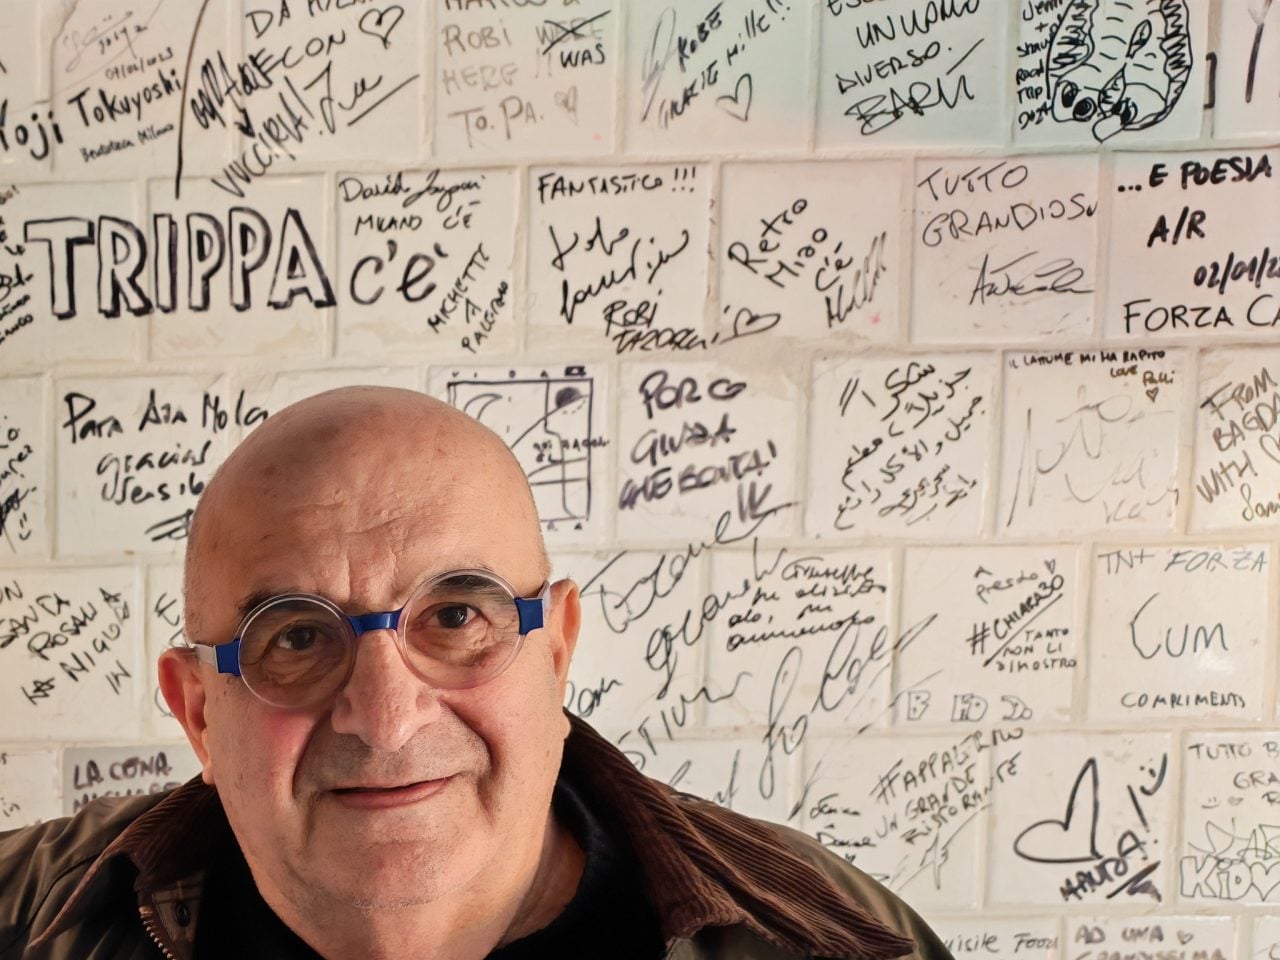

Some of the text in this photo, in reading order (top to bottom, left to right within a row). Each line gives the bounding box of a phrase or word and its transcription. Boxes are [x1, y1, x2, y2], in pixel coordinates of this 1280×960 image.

[560, 44, 606, 69] WAS
[67, 69, 182, 127] Tokuyoshi
[917, 162, 1029, 201] TUTTO
[1181, 154, 1272, 190] POESIA
[728, 199, 807, 274] Retro
[1147, 207, 1206, 248] A/R
[24, 208, 337, 319] TRIPPA
[1123, 297, 1236, 333] FORZA
[1200, 367, 1278, 421] FROM
[63, 392, 123, 444] Para
[1164, 550, 1268, 573] FORZA
[1188, 743, 1252, 760] TUTTO
[1014, 932, 1058, 953] Food
[1075, 924, 1164, 944] AD UNA
